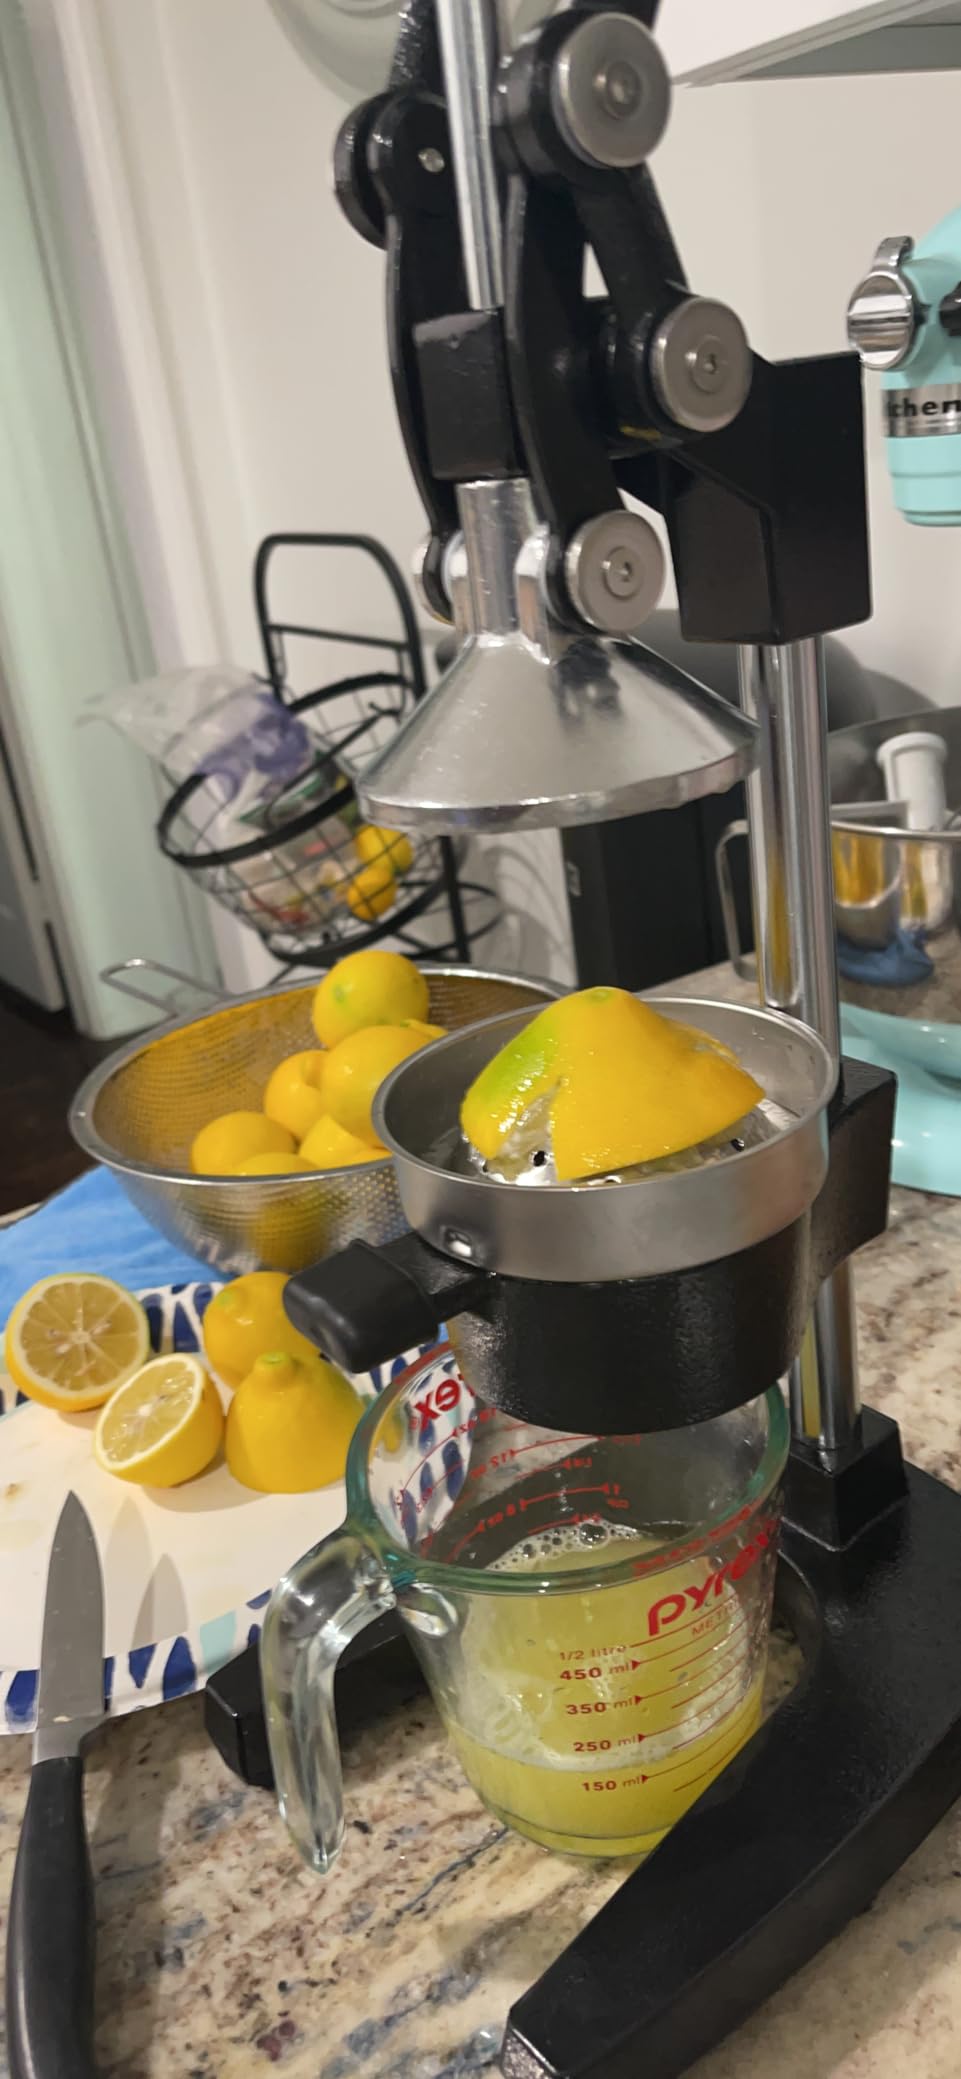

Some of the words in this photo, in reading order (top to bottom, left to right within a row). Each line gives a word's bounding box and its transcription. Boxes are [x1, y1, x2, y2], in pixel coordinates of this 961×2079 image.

[560, 1648, 584, 1661] 1/2
[560, 1666, 602, 1681] 450
[609, 1662, 630, 1674] ml
[566, 1702, 607, 1716] 350
[613, 1697, 633, 1709] ml
[574, 1739, 612, 1753] 250
[618, 1735, 636, 1747] ml
[582, 1780, 617, 1792] 150
[622, 1776, 640, 1788] ml
